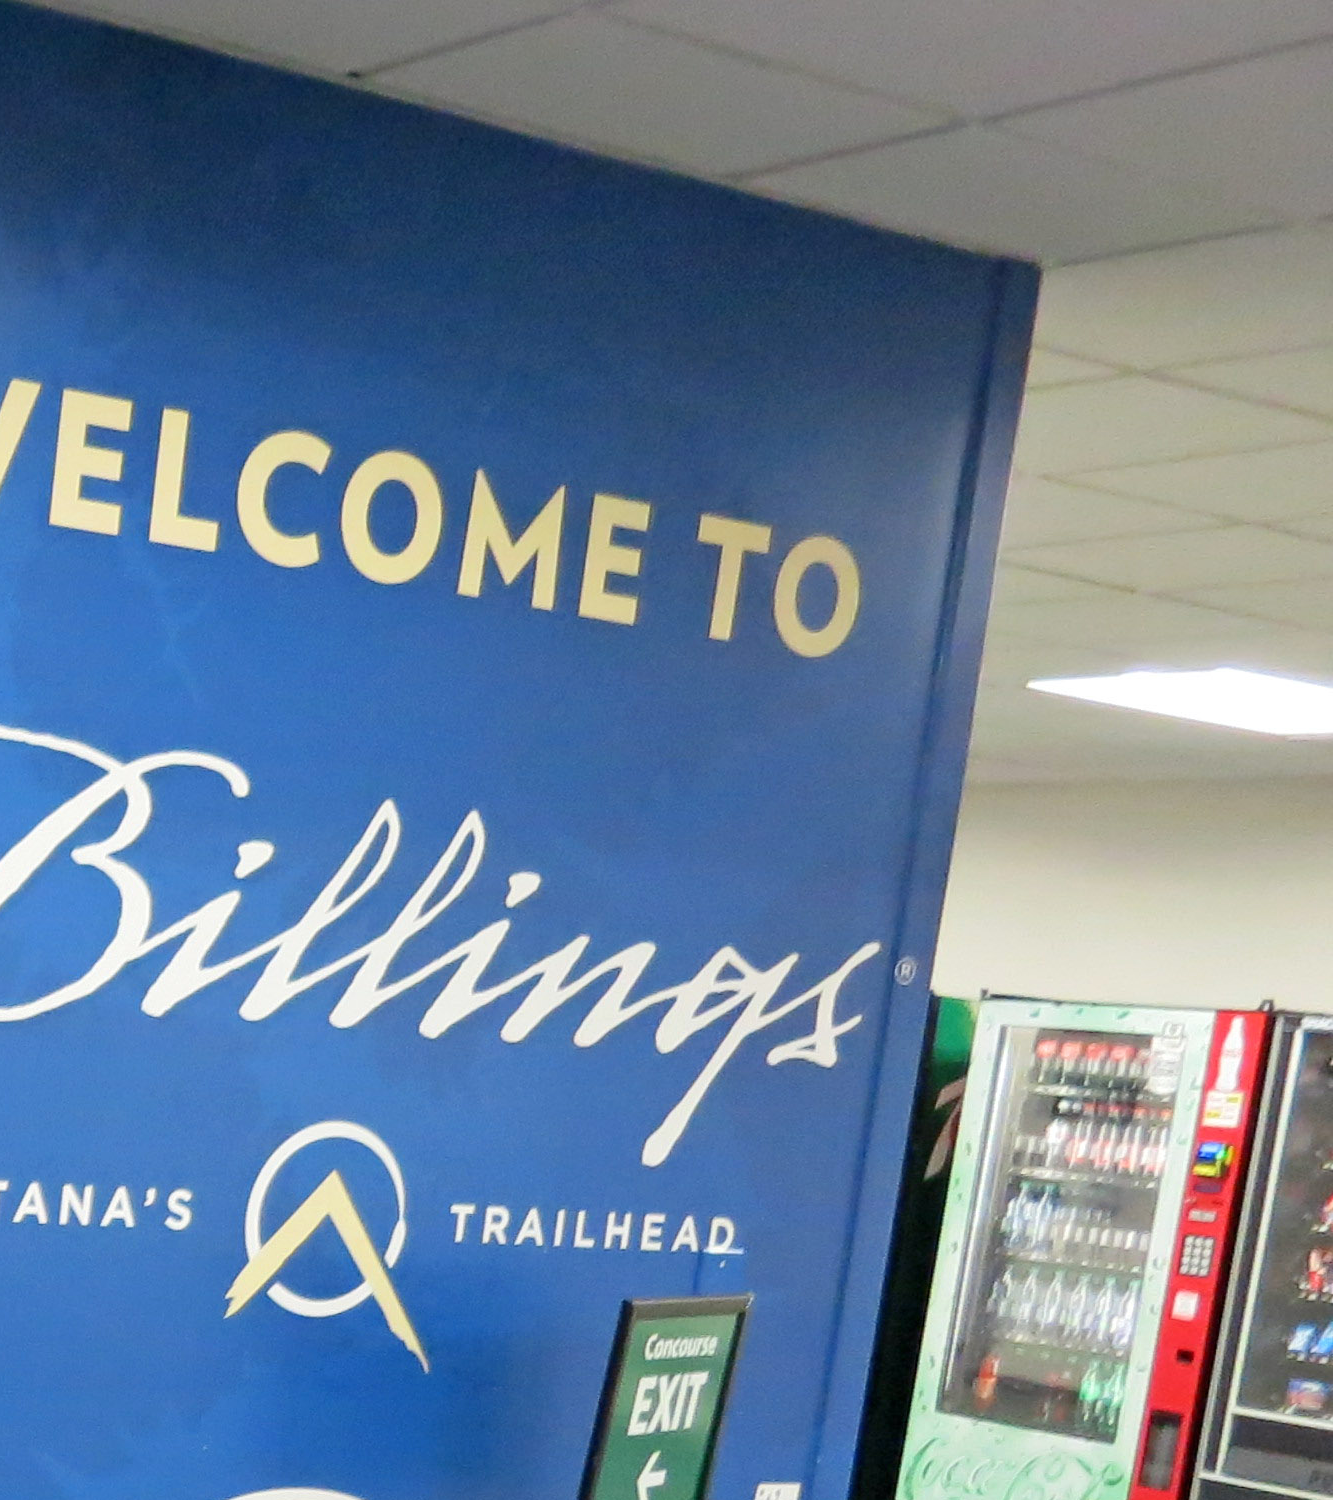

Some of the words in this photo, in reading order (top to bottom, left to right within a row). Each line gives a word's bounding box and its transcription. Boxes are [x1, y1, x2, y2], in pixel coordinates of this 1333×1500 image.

[698, 512, 860, 657] TO
[451, 1203, 735, 1254] TRAILHEAD
[644, 1333, 718, 1360] Concourse
[628, 1371, 709, 1436] EXIT
